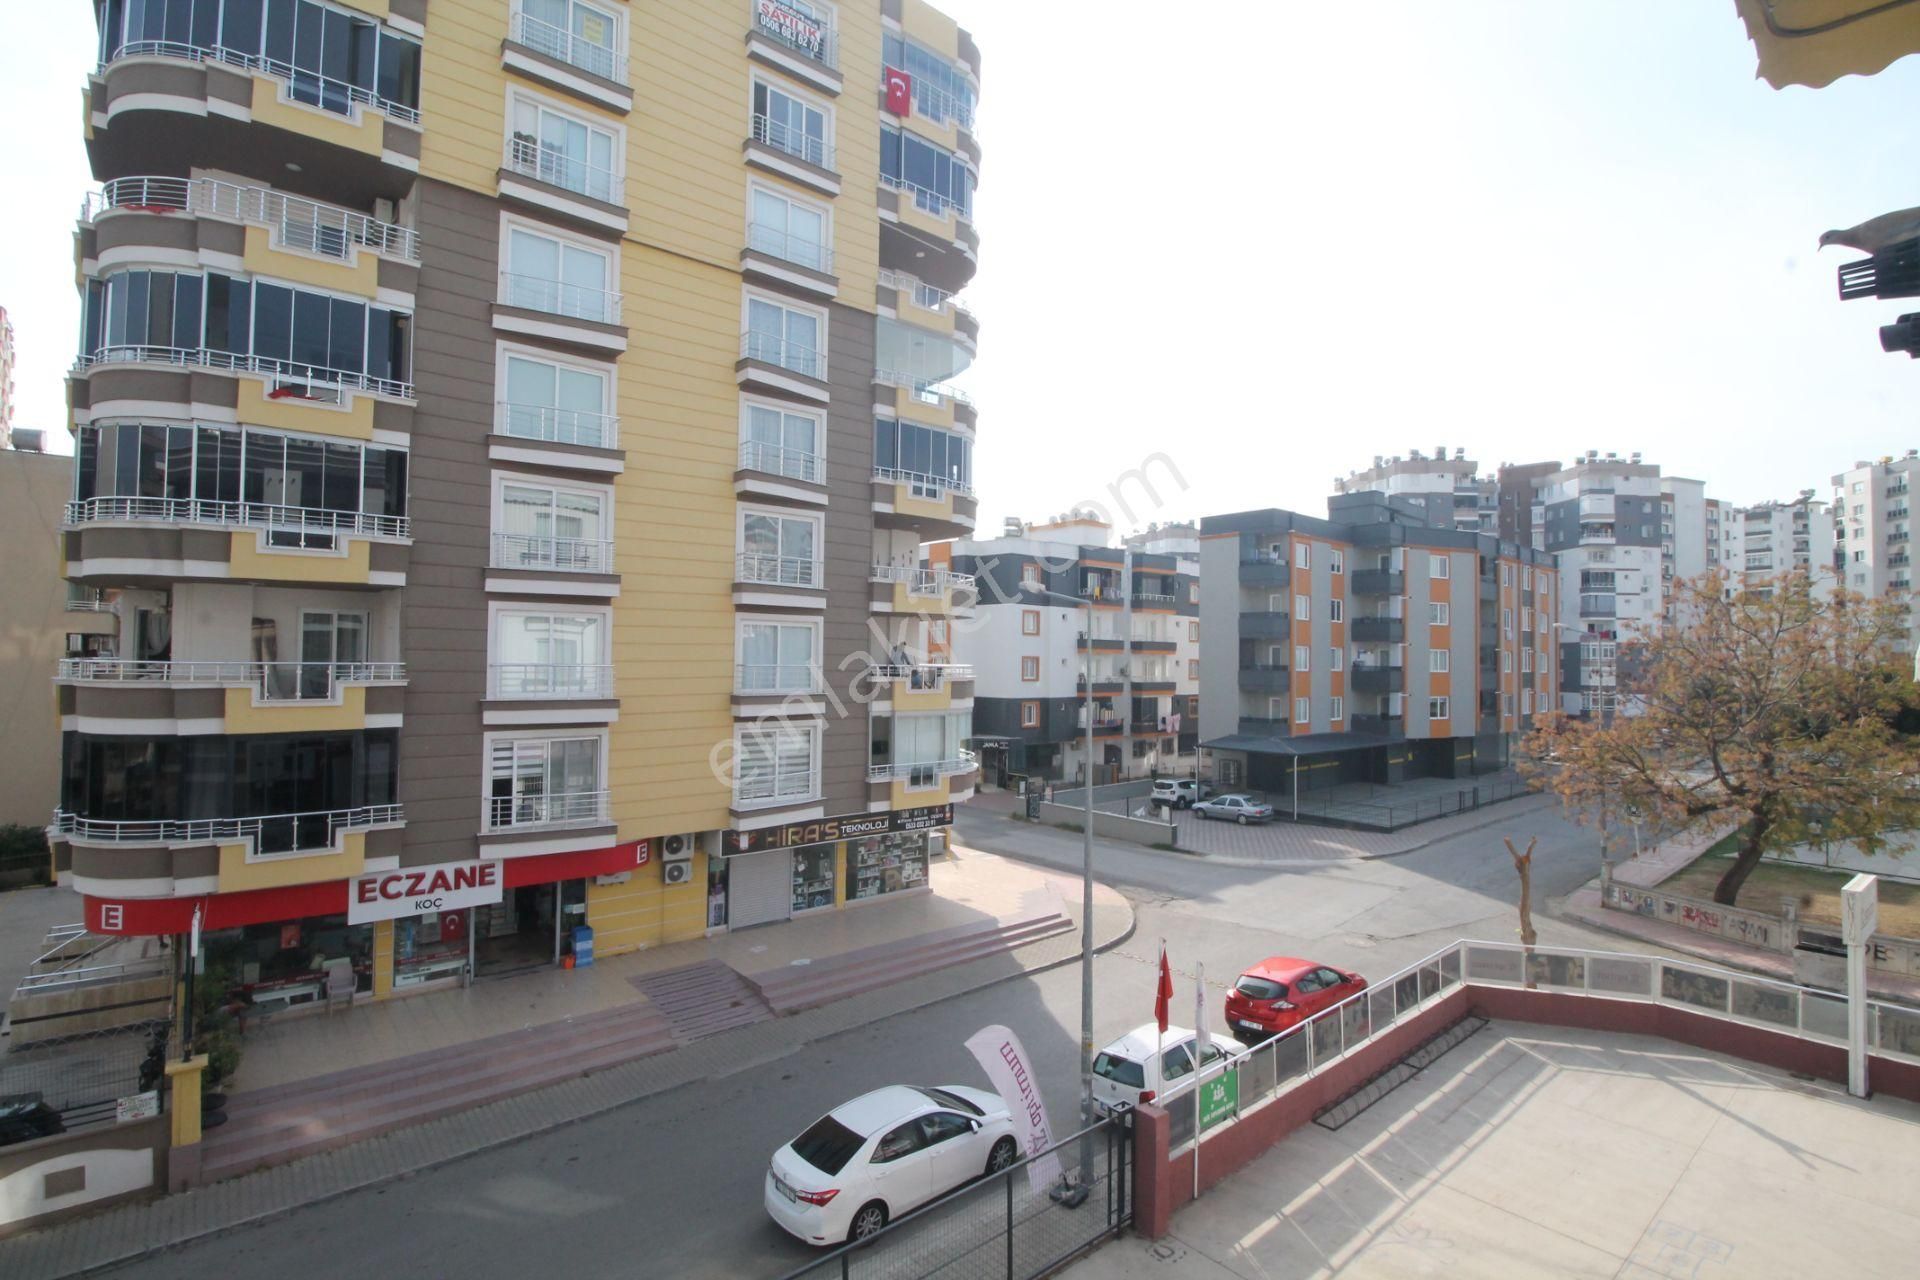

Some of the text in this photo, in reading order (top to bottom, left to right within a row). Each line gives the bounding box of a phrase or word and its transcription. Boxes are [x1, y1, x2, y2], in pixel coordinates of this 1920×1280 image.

[760, 2, 820, 38] SATILIK
[760, 14, 780, 33] 0506
[797, 34, 808, 47] 62
[809, 38, 819, 52] 70
[840, 820, 889, 835] TEKNOLOJİ
[358, 863, 496, 904] ECZANE
[103, 906, 121, 928] E
[415, 898, 443, 911] KOÇ
[999, 1041, 1043, 1127] optimum
